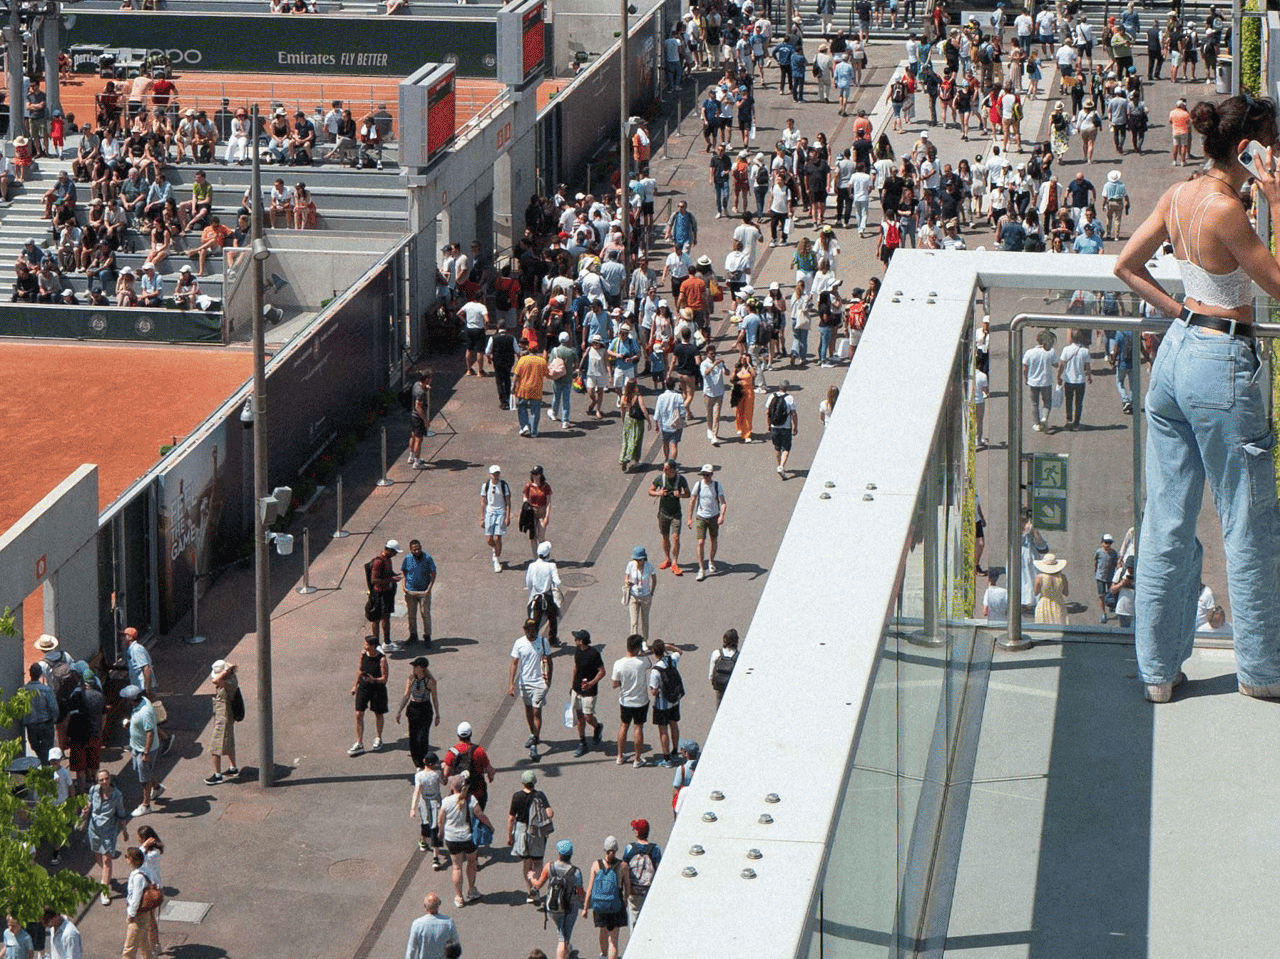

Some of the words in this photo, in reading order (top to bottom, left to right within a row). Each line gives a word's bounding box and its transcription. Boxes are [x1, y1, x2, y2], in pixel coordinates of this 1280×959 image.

[277, 51, 336, 65] Emirates
[340, 52, 358, 66] FLY
[359, 52, 388, 67] BETTER
[171, 524, 197, 561] GAME
